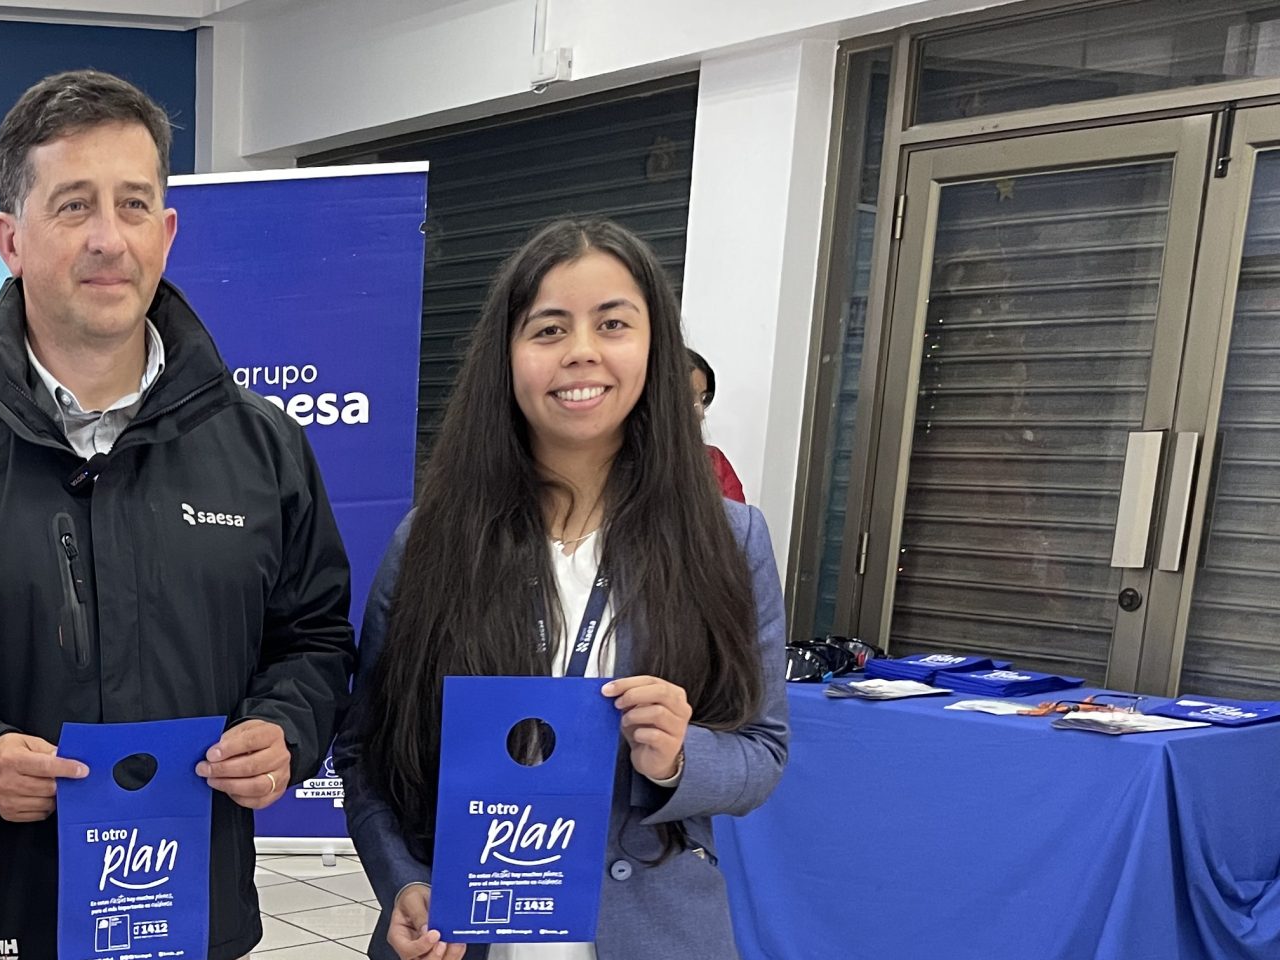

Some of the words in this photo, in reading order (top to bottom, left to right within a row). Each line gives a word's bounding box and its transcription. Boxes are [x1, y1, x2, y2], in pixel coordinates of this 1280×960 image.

[232, 364, 318, 390] grupo
[197, 510, 244, 528] saesa
[309, 781, 326, 789] QUE
[469, 800, 484, 815] El
[486, 802, 519, 815] otro
[86, 828, 99, 843] El
[101, 828, 128, 841] otro
[479, 804, 576, 865] plan
[99, 828, 178, 891] plan
[522, 900, 554, 911] 1412
[140, 922, 168, 935] 1412
